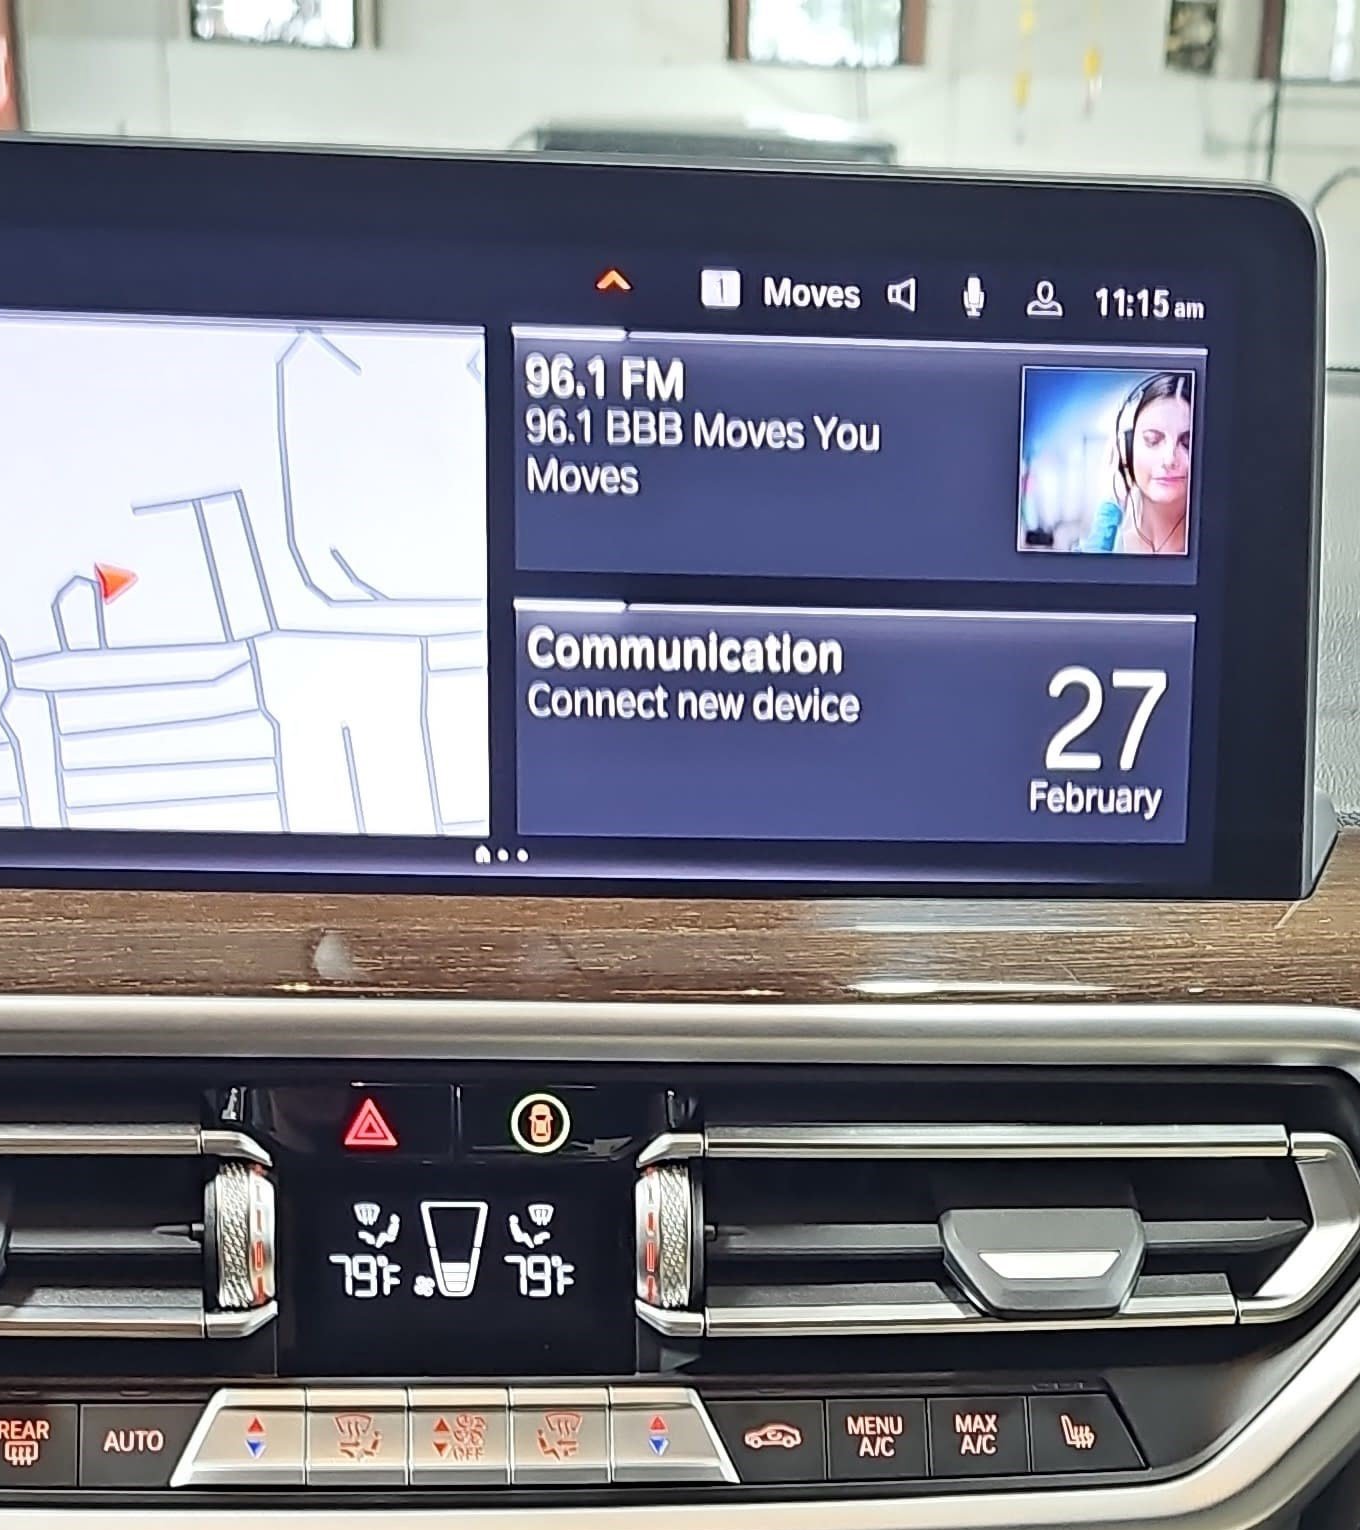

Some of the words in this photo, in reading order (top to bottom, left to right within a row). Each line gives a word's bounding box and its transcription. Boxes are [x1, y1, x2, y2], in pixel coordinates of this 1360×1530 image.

[763, 275, 862, 310] Moves
[525, 352, 607, 398] 96.1
[622, 357, 686, 401] FM
[525, 409, 593, 447] 96.1
[606, 411, 683, 448] BBB
[693, 414, 805, 452] Moves
[813, 416, 881, 454] You
[526, 456, 640, 496] Moves
[527, 624, 843, 675] Communication
[527, 683, 669, 723] Connect
[677, 689, 744, 723] new
[751, 686, 861, 723] device
[1045, 667, 1167, 771] 27
[1029, 780, 1163, 820] February
[103, 1430, 164, 1454] AUTO
[847, 1415, 903, 1437] MENU
[954, 1415, 998, 1434] MAX
[960, 1434, 997, 1455] A/C
[859, 1436, 896, 1458] A/C
